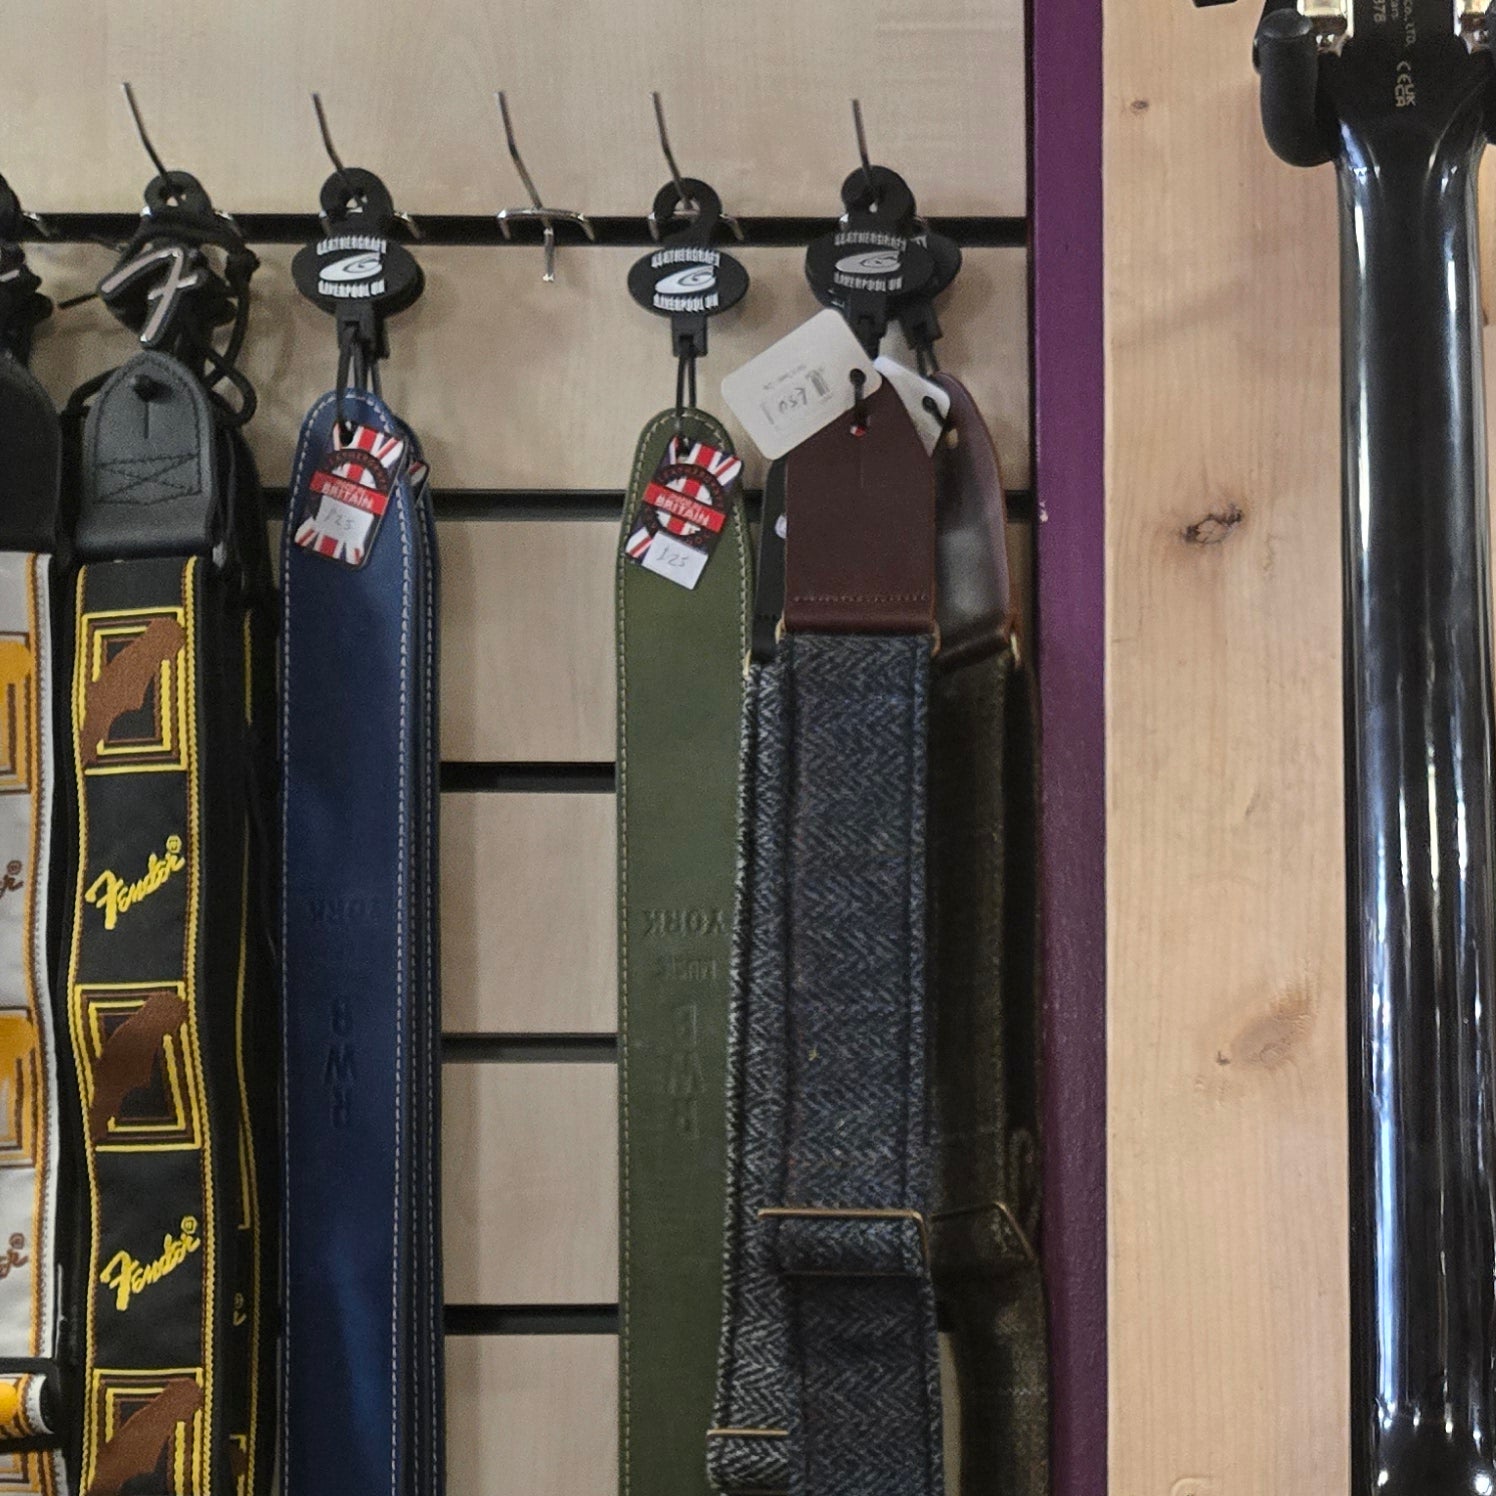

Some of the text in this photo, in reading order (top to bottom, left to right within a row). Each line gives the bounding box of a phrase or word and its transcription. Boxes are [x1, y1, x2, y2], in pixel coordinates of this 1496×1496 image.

[320, 481, 375, 510] BRITAIN
[654, 494, 710, 526] BRITAIN
[85, 852, 186, 931] Fender
[100, 1233, 201, 1312] Fender
